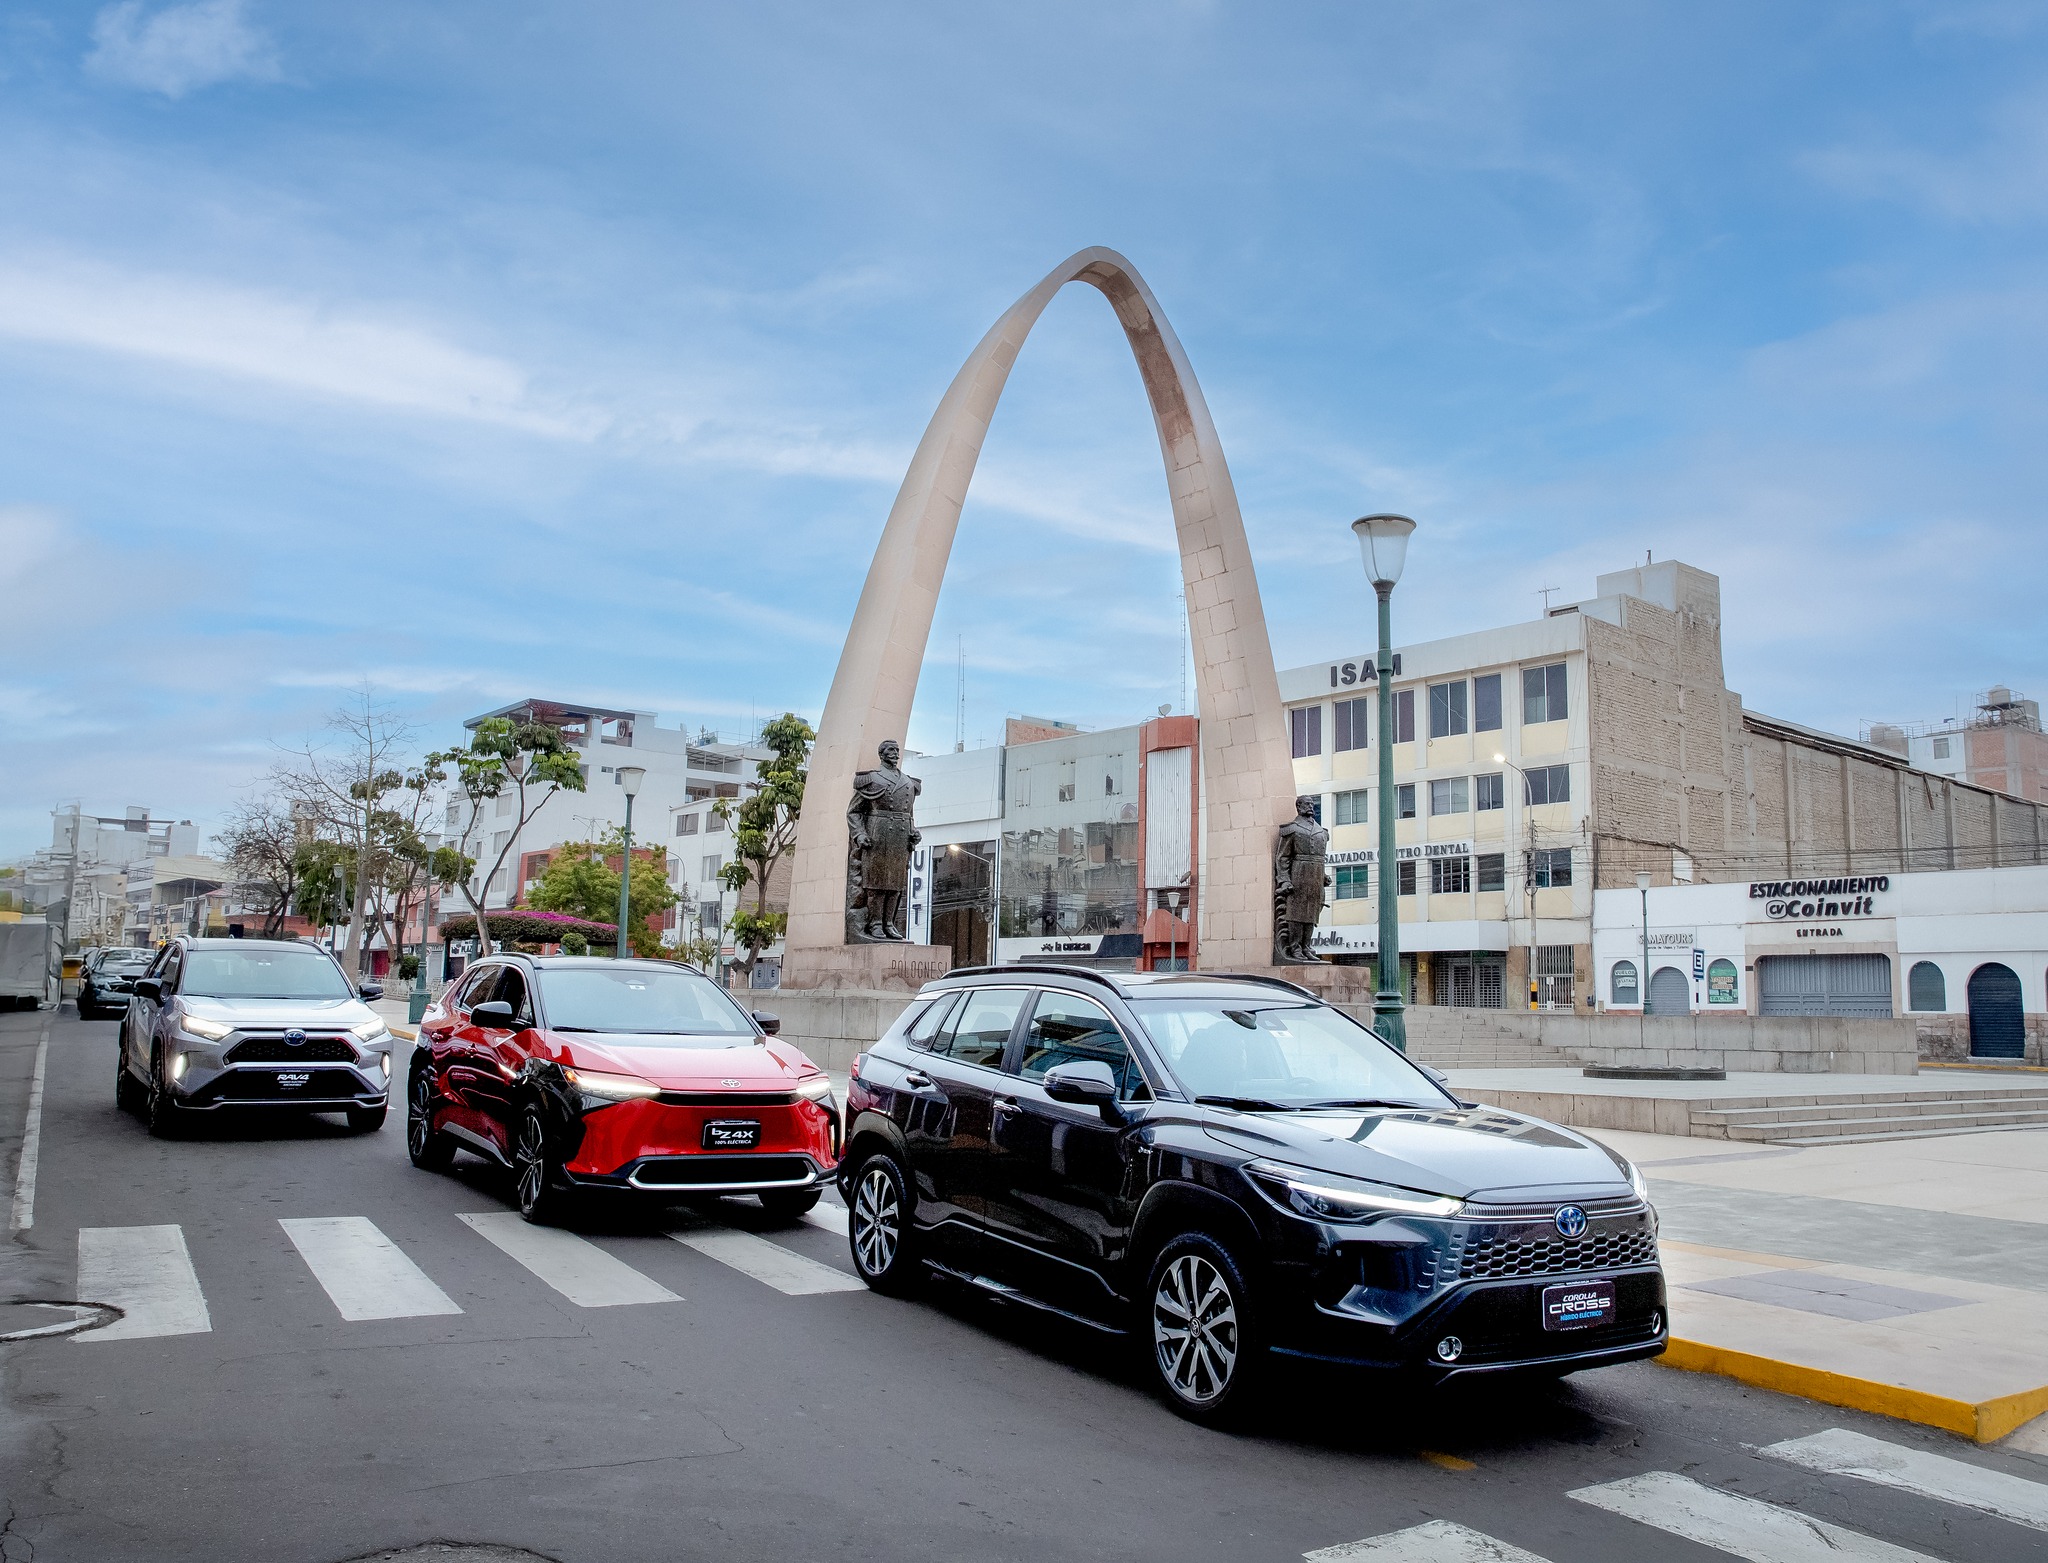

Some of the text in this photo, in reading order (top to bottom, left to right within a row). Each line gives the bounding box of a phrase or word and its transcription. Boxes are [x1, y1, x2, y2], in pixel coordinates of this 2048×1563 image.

[1324, 850, 1375, 864] SALVADOR
[1424, 843, 1469, 857] DENTAL
[1749, 875, 1890, 899] ESTACIONAMIENTO
[1787, 895, 1873, 918] Coinvit
[1638, 933, 1694, 945] SMATOURS
[1796, 927, 1843, 938] ENTRADA
[1346, 941, 1379, 949] EXPR
[1696, 954, 1702, 968] E
[892, 960, 948, 979] BOLOGNESI
[277, 1073, 310, 1081] RAV4
[1562, 1291, 1597, 1303] COROLLA
[1549, 1297, 1611, 1315] CROSS
[1560, 1310, 1603, 1321] HÍBRIDO ELÉCTRICO
